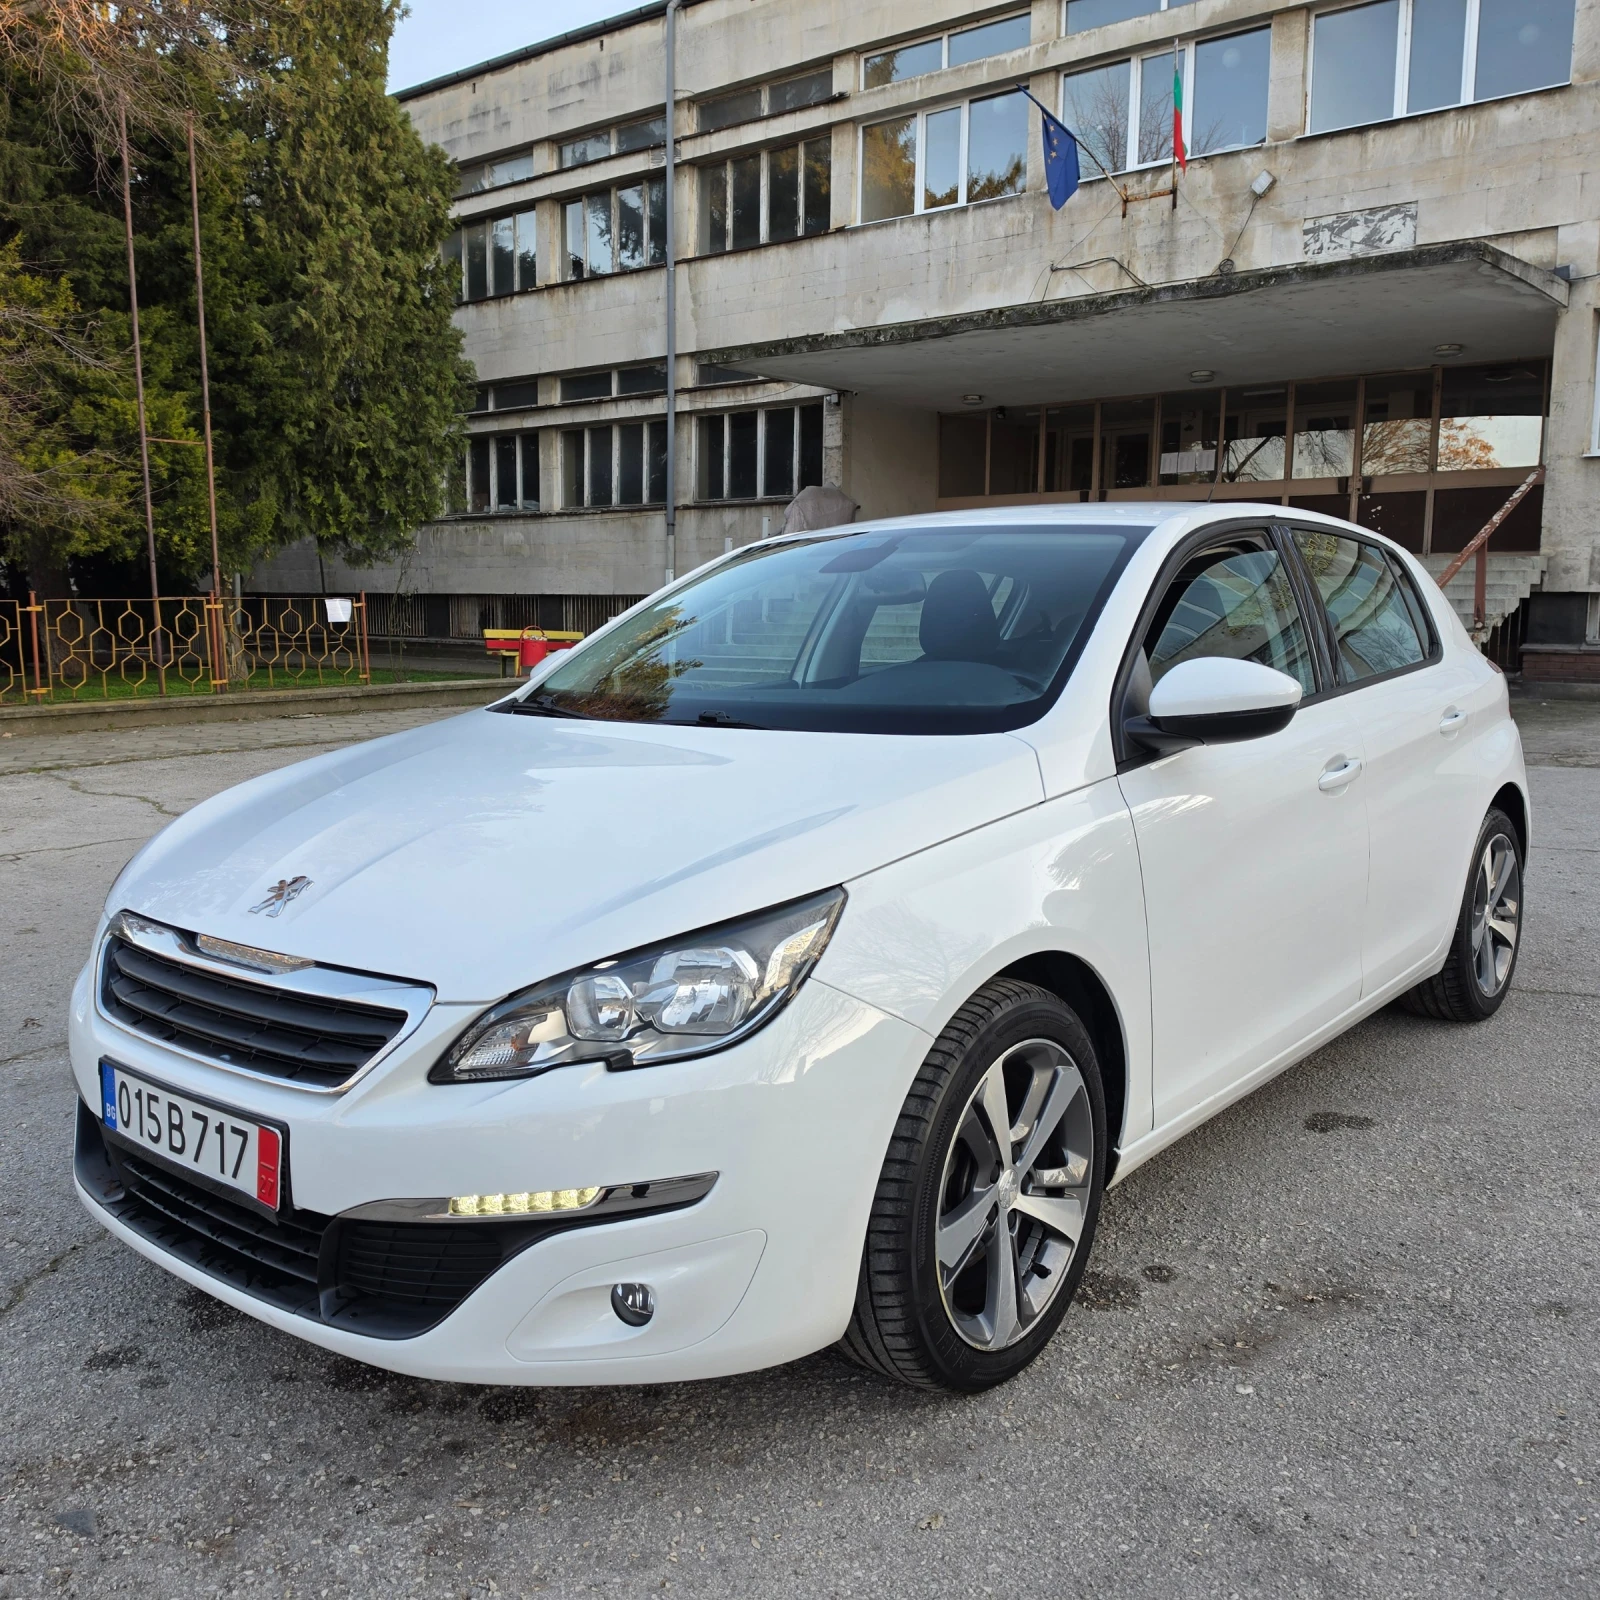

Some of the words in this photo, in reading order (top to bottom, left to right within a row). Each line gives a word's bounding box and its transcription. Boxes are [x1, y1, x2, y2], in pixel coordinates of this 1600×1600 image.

[106, 1102, 116, 1120] BG
[118, 1080, 249, 1180] 015B717
[260, 1174, 275, 1197] 27
